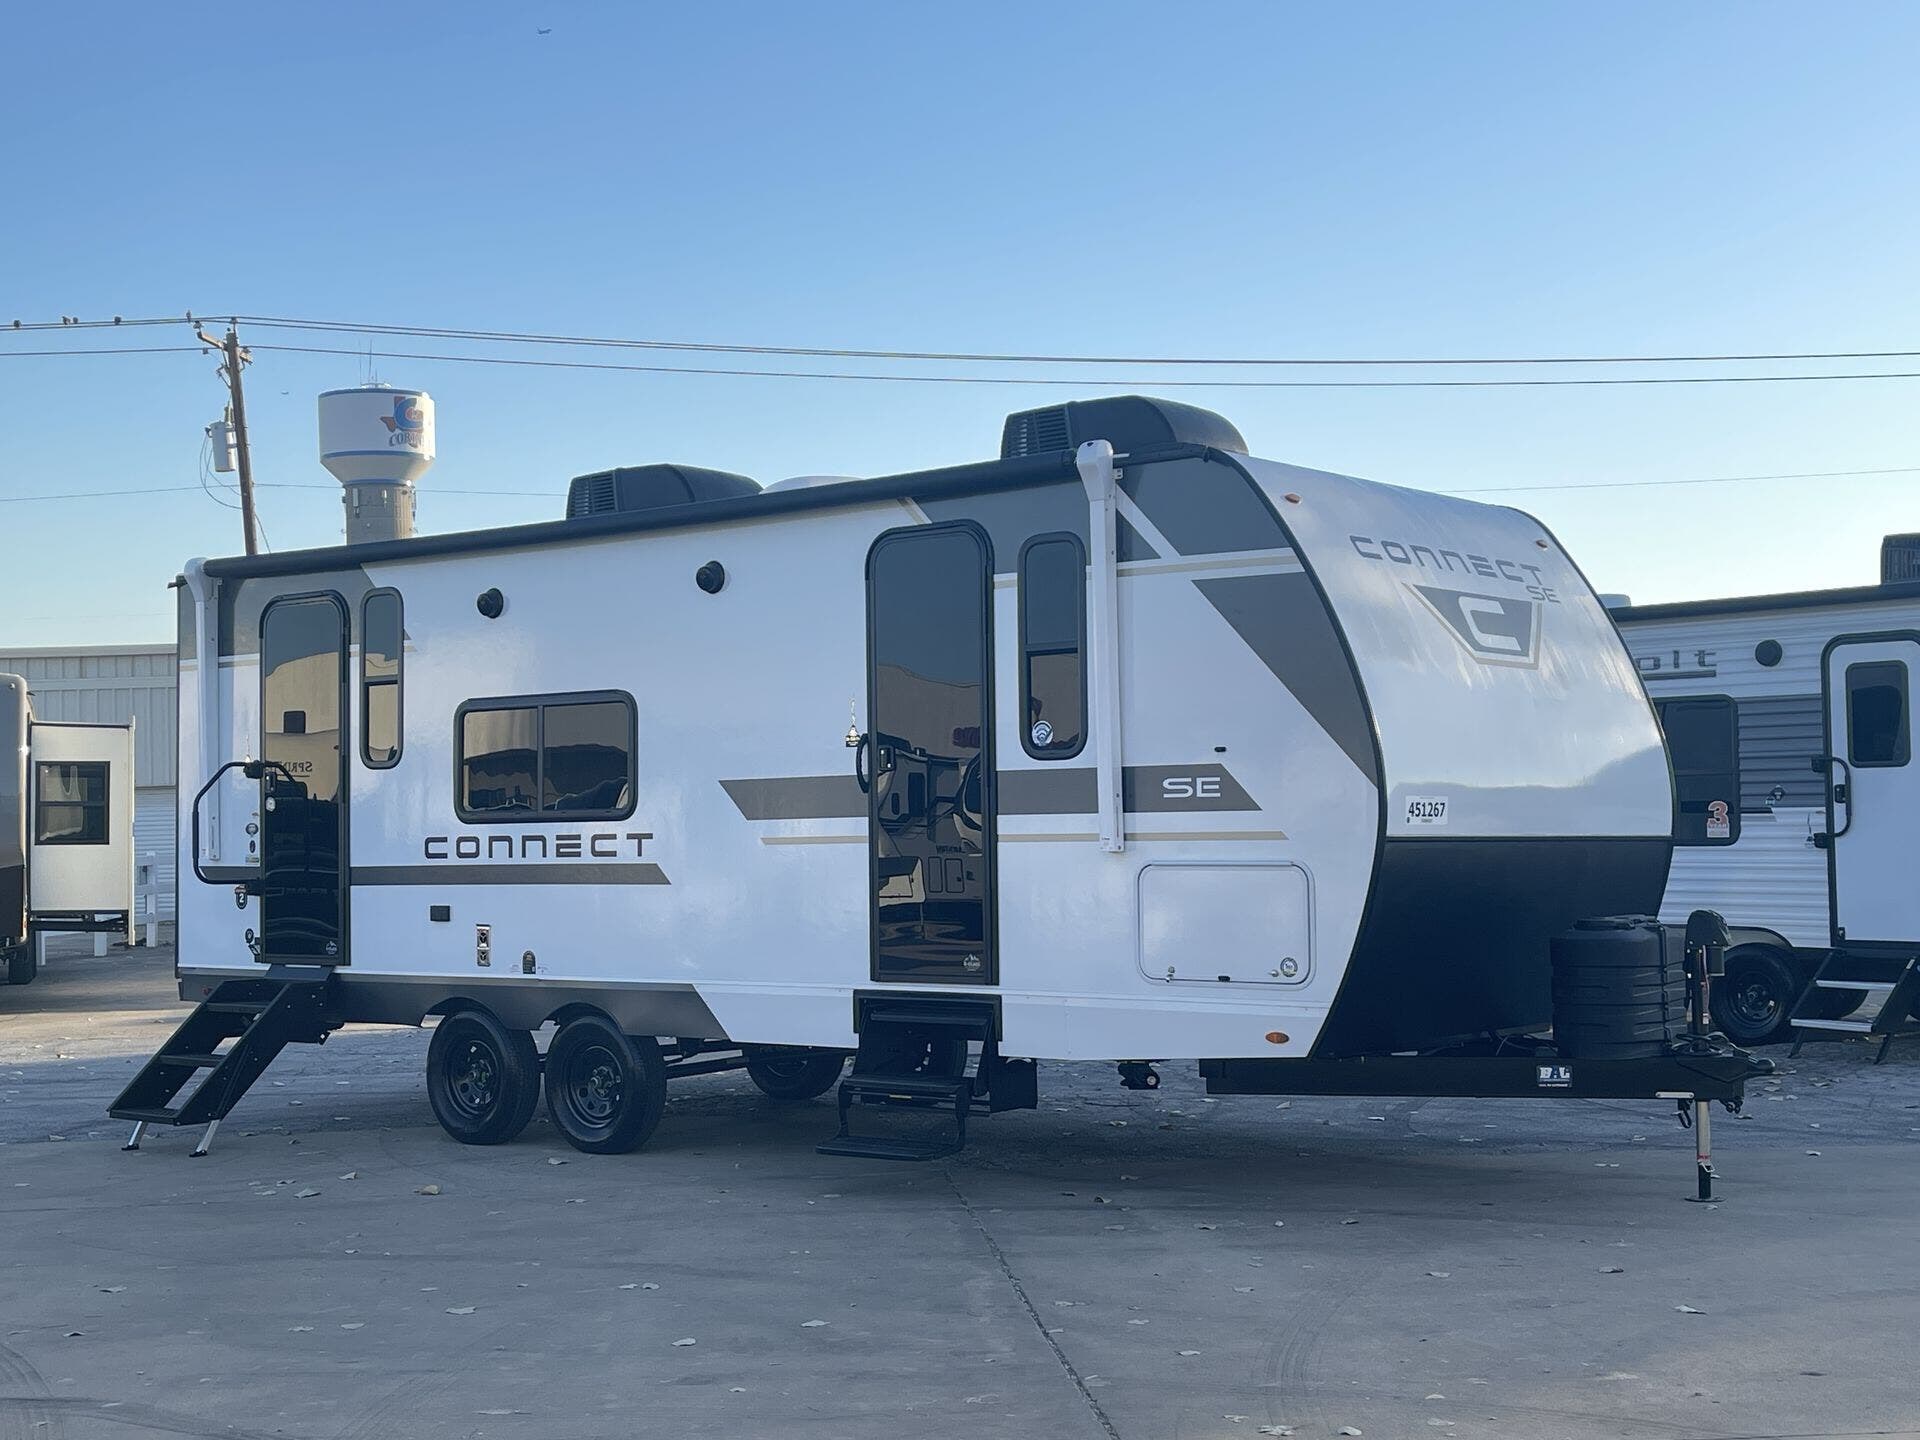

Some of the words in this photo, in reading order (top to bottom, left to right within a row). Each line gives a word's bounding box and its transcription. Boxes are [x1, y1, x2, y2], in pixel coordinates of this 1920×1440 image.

[1349, 535, 1542, 585] CONNECT
[1526, 585, 1561, 604] SE
[1634, 650, 1717, 671] olt
[1162, 777, 1220, 798] SE
[1408, 802, 1446, 817] 451267
[1708, 800, 1728, 825] 3
[424, 833, 653, 859] CONNECT
